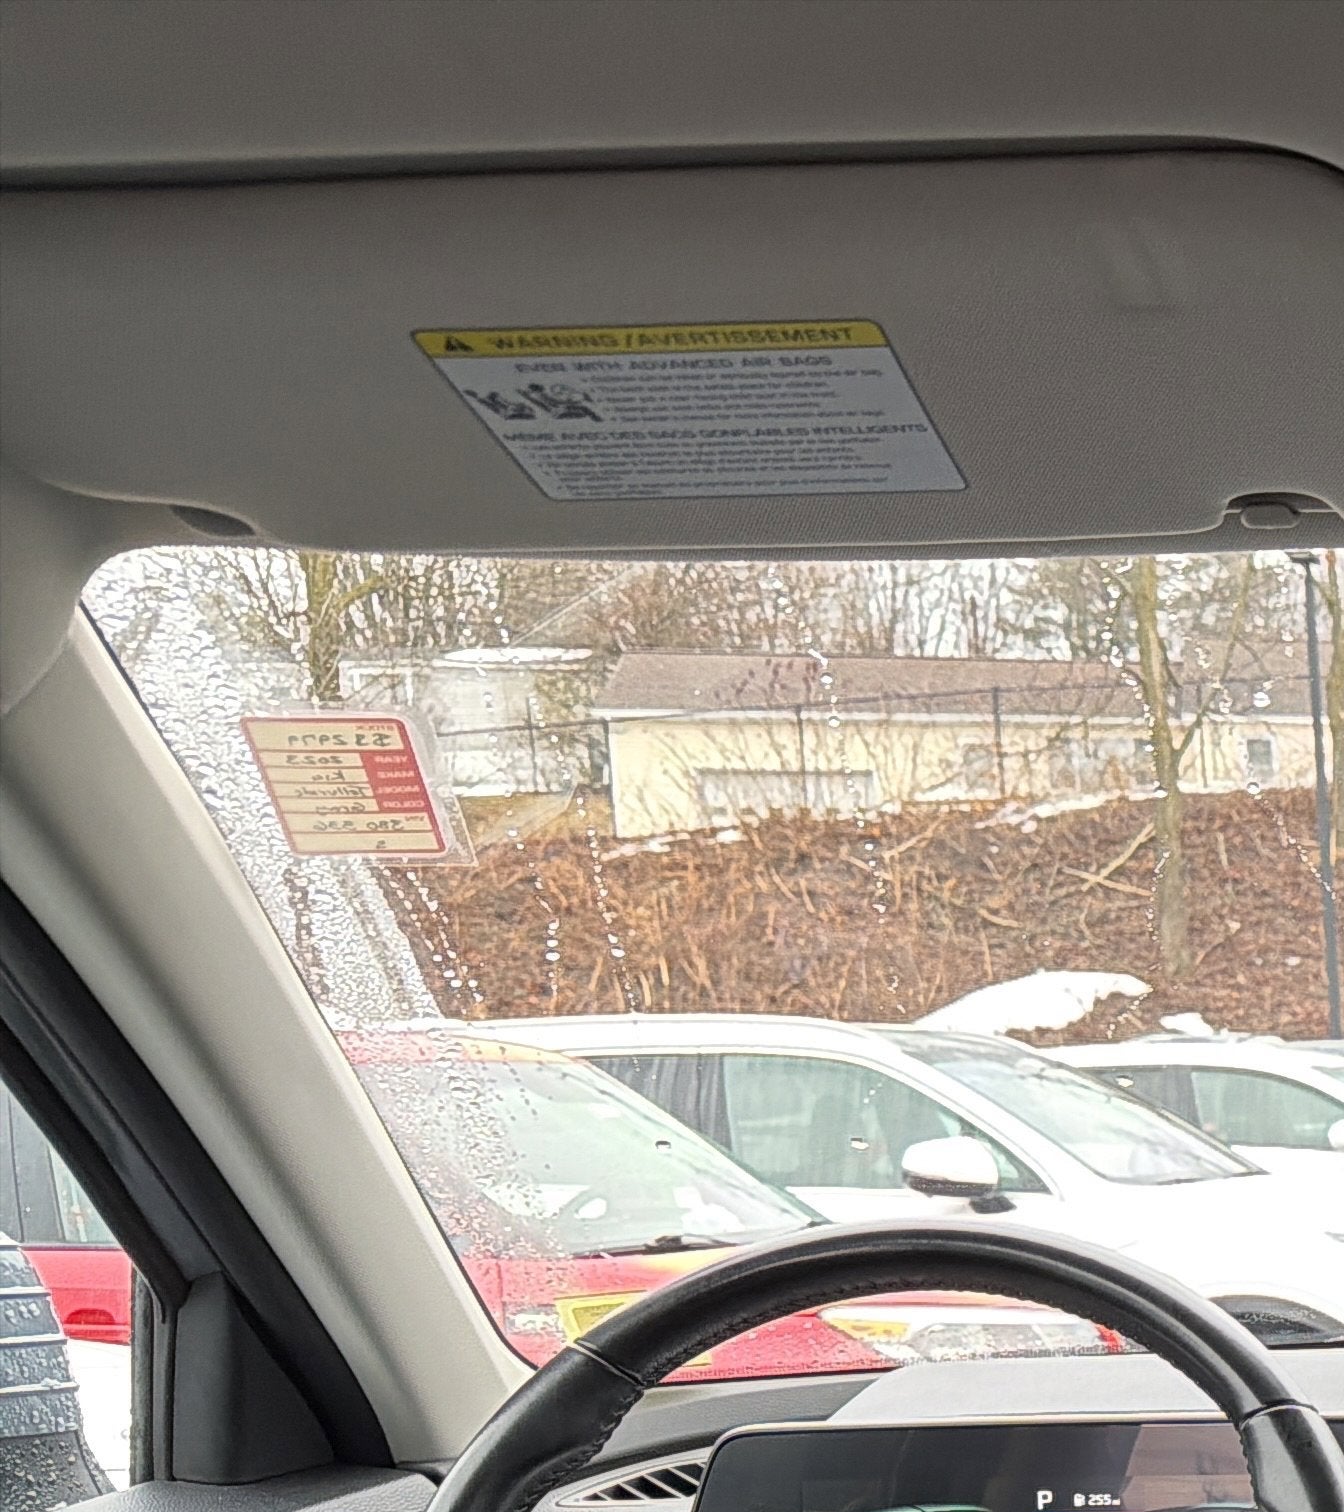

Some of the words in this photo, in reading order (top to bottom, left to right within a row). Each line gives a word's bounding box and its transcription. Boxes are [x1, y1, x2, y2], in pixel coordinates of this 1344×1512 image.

[628, 357, 734, 371] ADVANCED
[1036, 1490, 1053, 1511] P
[1087, 1493, 1112, 1506] 255
